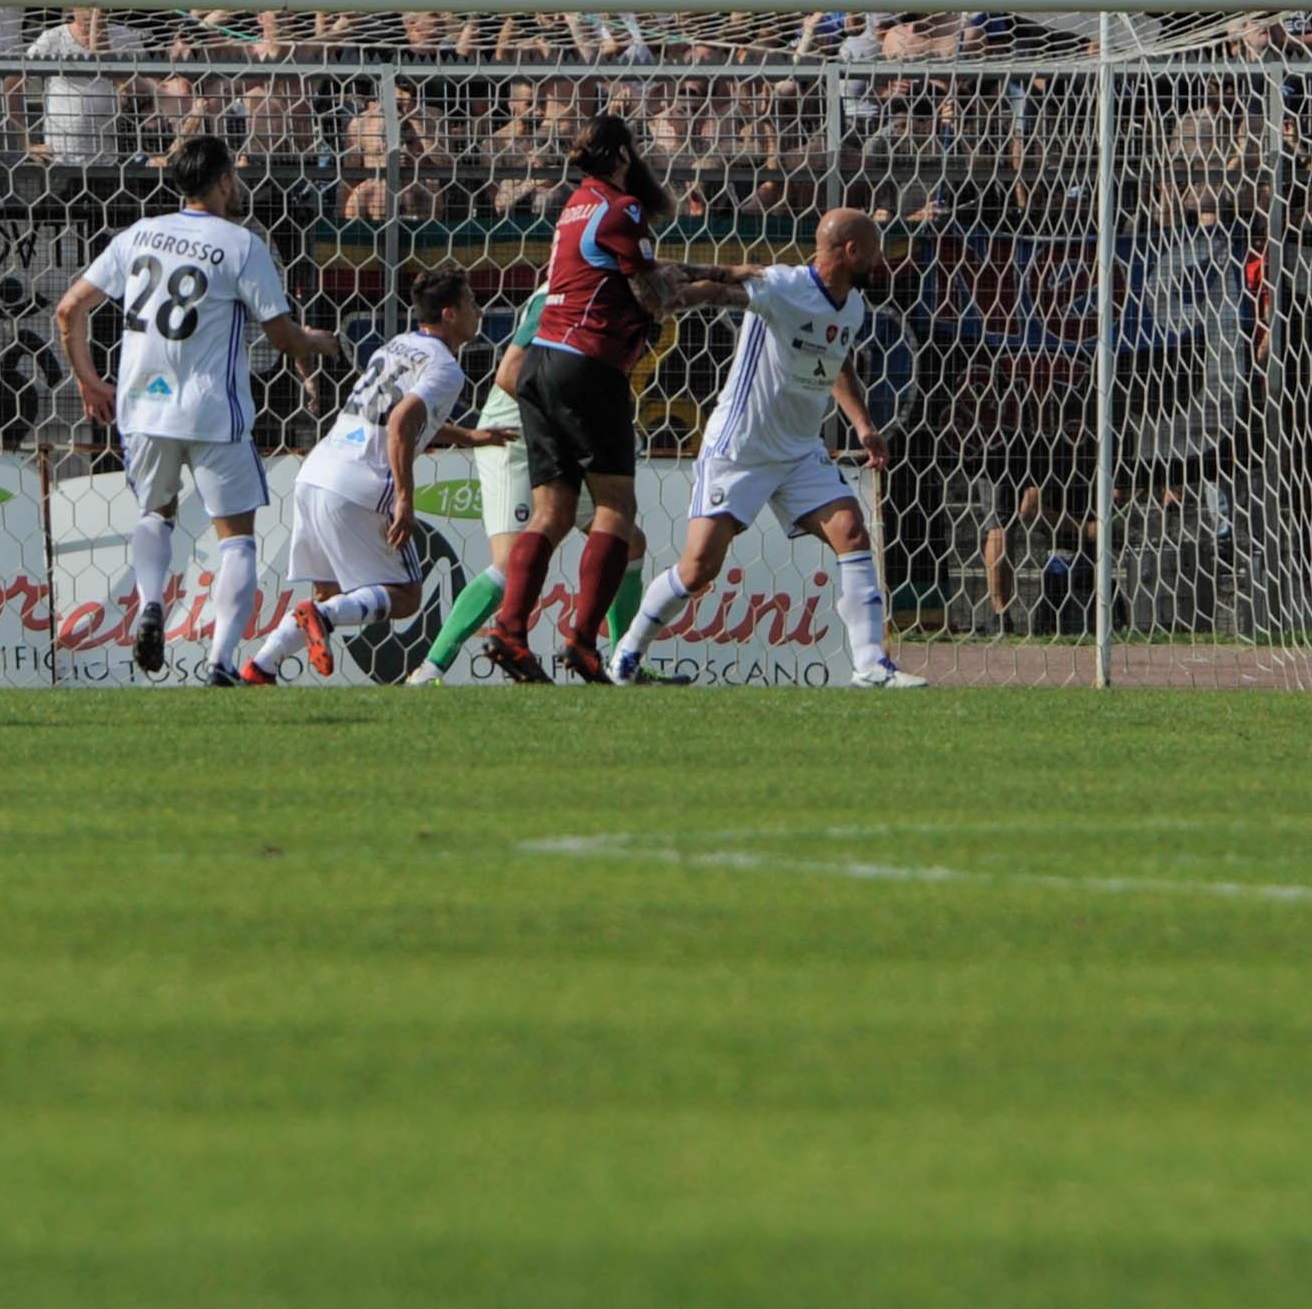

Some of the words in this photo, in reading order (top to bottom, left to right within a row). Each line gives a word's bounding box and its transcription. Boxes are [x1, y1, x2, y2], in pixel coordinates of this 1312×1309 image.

[132, 230, 225, 266] INGROSSO
[125, 254, 208, 341] 28
[438, 487, 482, 514] 195
[651, 658, 830, 687] TOSCANO
